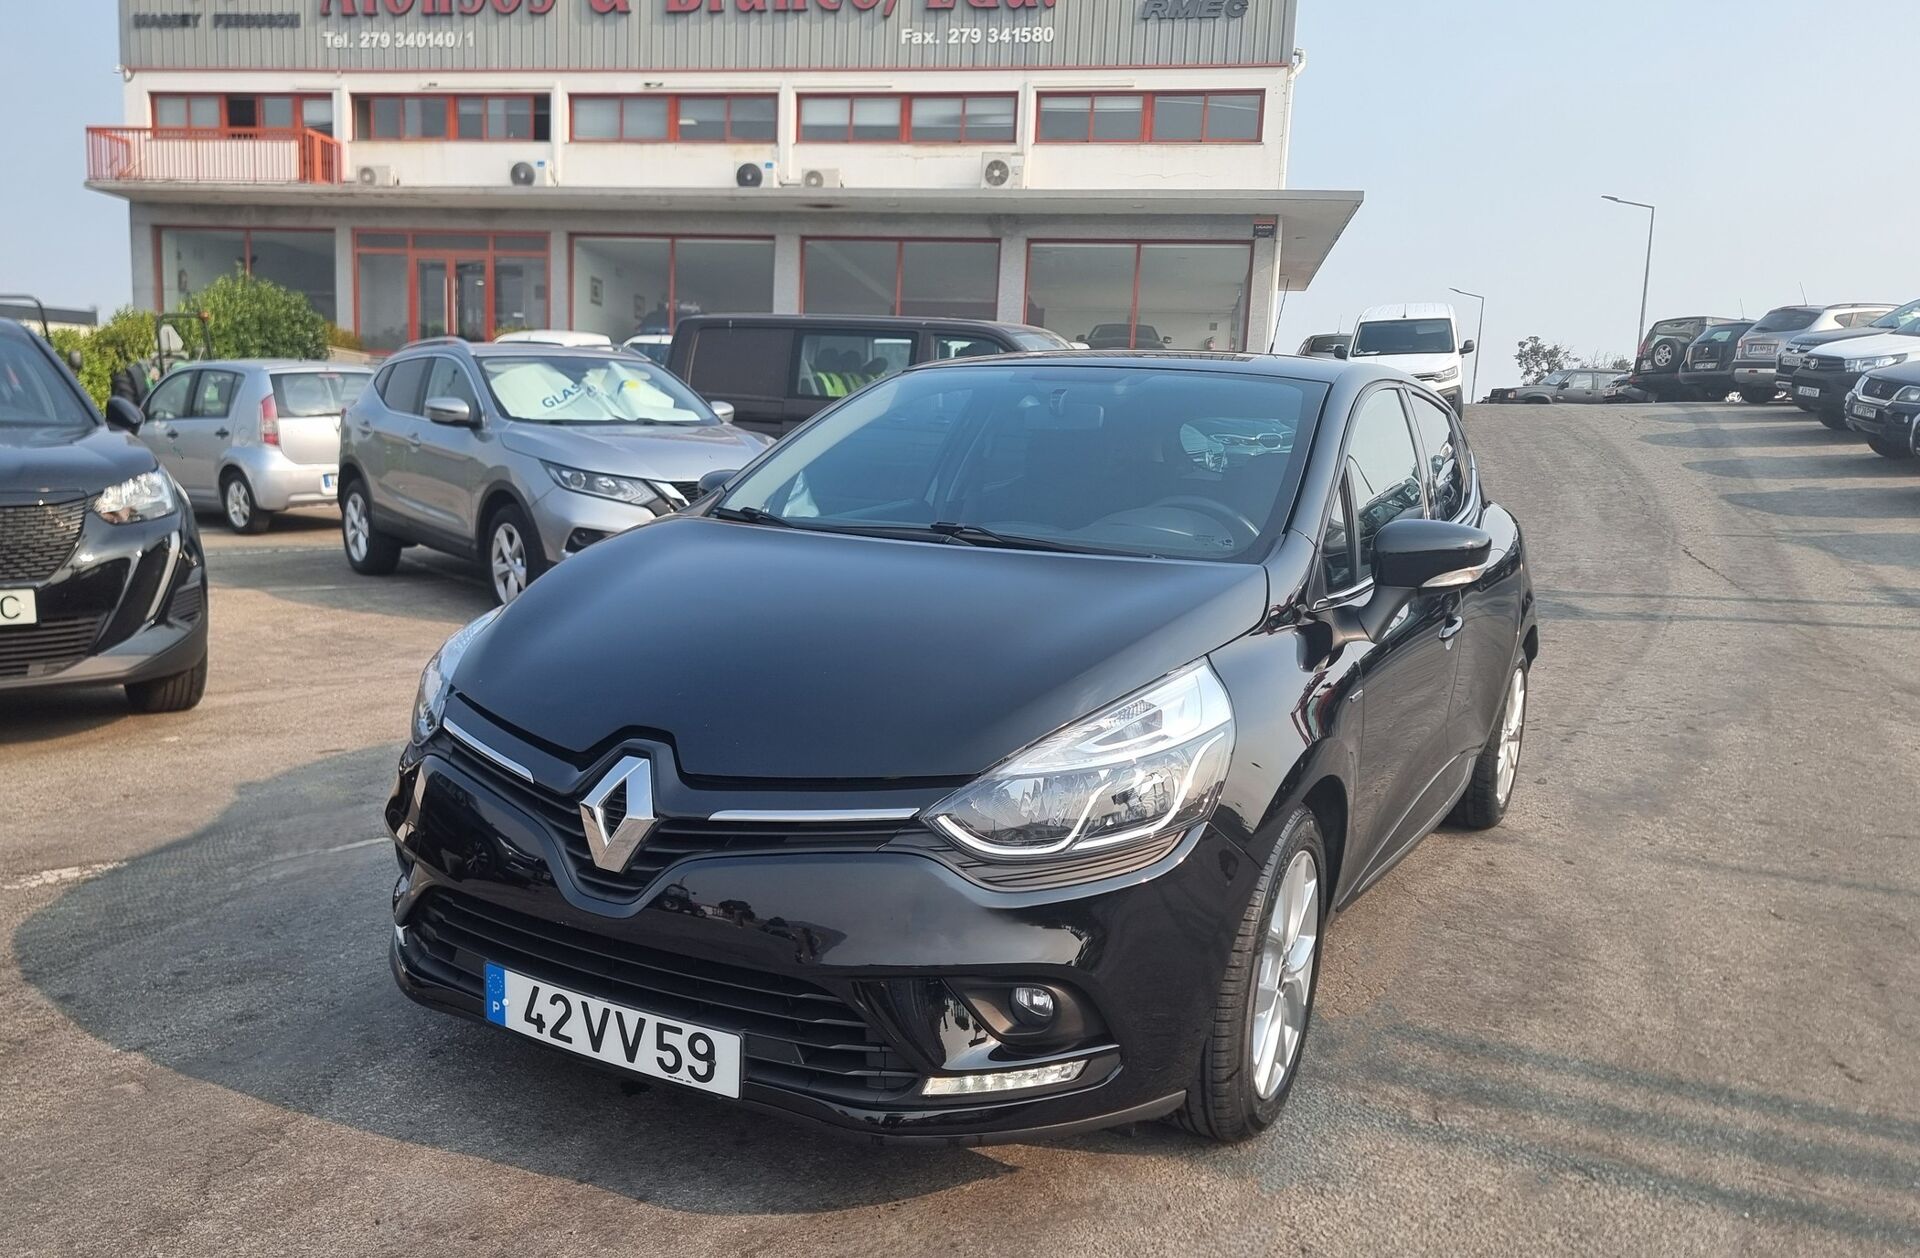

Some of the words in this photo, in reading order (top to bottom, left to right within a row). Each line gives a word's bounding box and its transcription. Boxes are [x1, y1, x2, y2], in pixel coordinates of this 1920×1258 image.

[322, 31, 353, 48] Tel.
[360, 31, 391, 48] 279
[901, 28, 940, 45] Fax.
[947, 28, 982, 44] 279
[987, 26, 1055, 44] 341580
[492, 1000, 501, 1013] P
